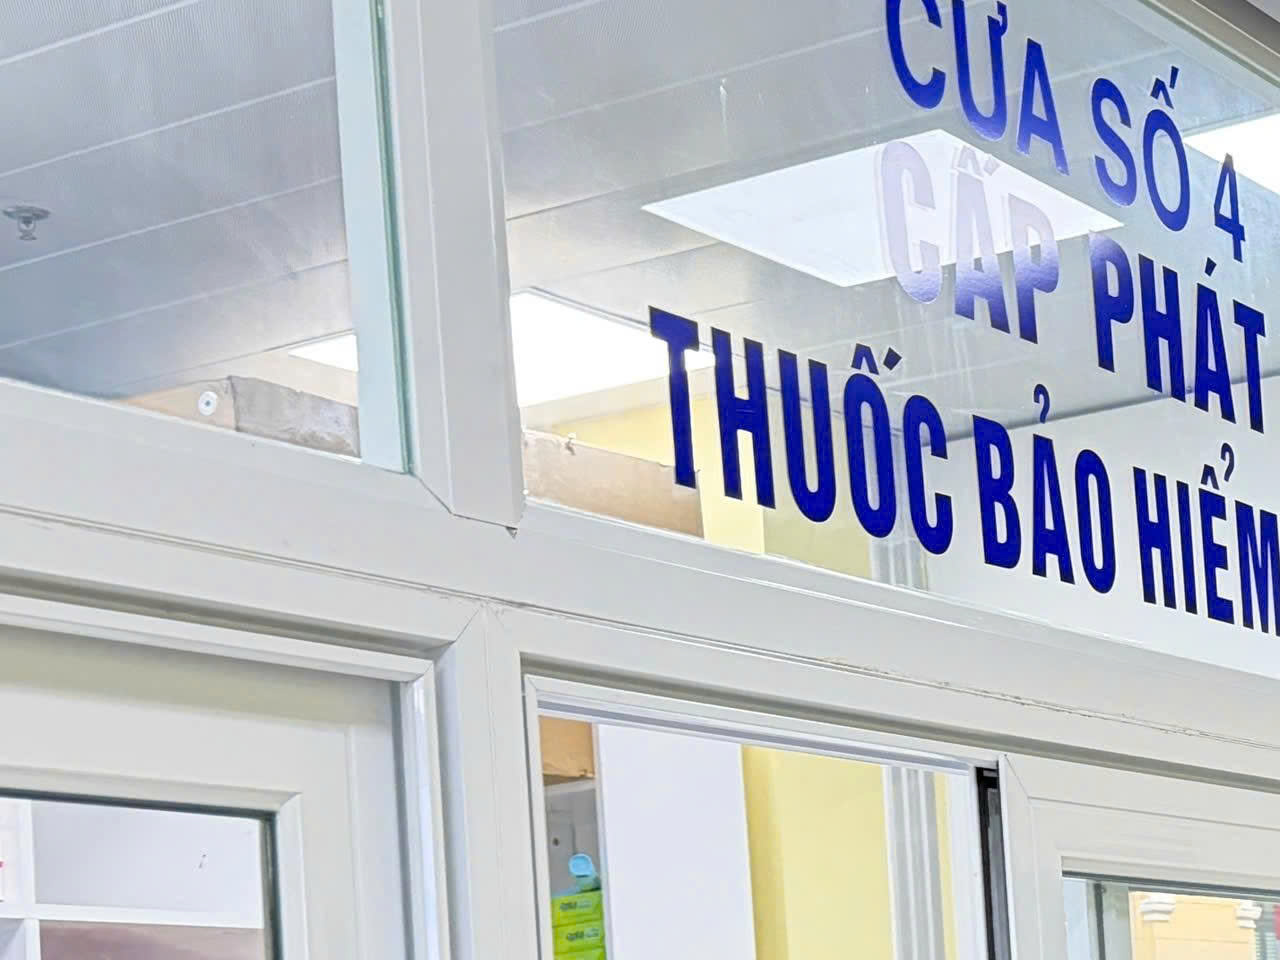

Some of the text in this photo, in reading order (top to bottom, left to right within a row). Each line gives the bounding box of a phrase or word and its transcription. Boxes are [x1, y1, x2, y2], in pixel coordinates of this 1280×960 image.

[881, 141, 1266, 434] CẤP PHÁT
[1091, 66, 1190, 232] SỐ
[1214, 153, 1246, 263] 4
[648, 305, 953, 556] THUỐC
[972, 384, 1116, 594] BẢO
